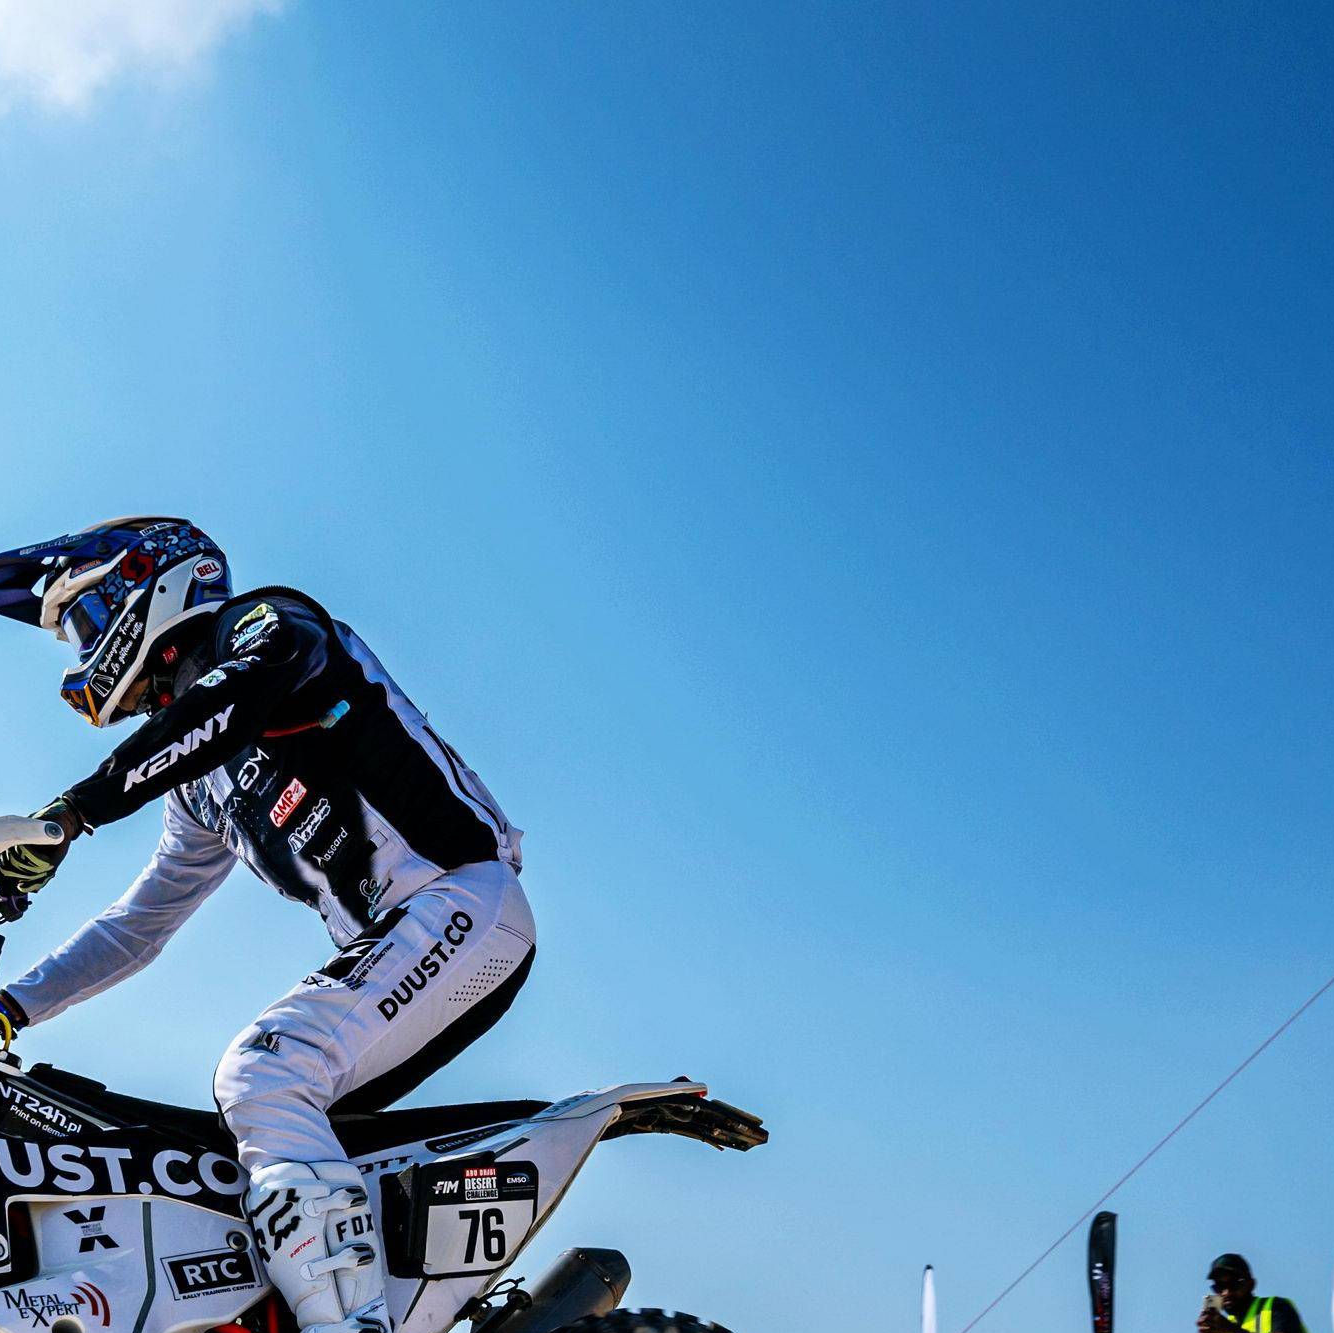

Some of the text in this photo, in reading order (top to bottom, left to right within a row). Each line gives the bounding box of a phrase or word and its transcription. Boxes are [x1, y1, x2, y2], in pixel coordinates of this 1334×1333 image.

[196, 562, 220, 579] BELL
[123, 703, 237, 792] KENNY
[377, 910, 474, 1022] DUUST.CO
[358, 1154, 413, 1176] OTT
[464, 1176, 498, 1190] DESERT
[335, 1213, 374, 1243] FOX
[458, 1207, 507, 1264] 76
[182, 1258, 243, 1286] RTC
[182, 1283, 256, 1301] RALLY TRAINING CENTER
